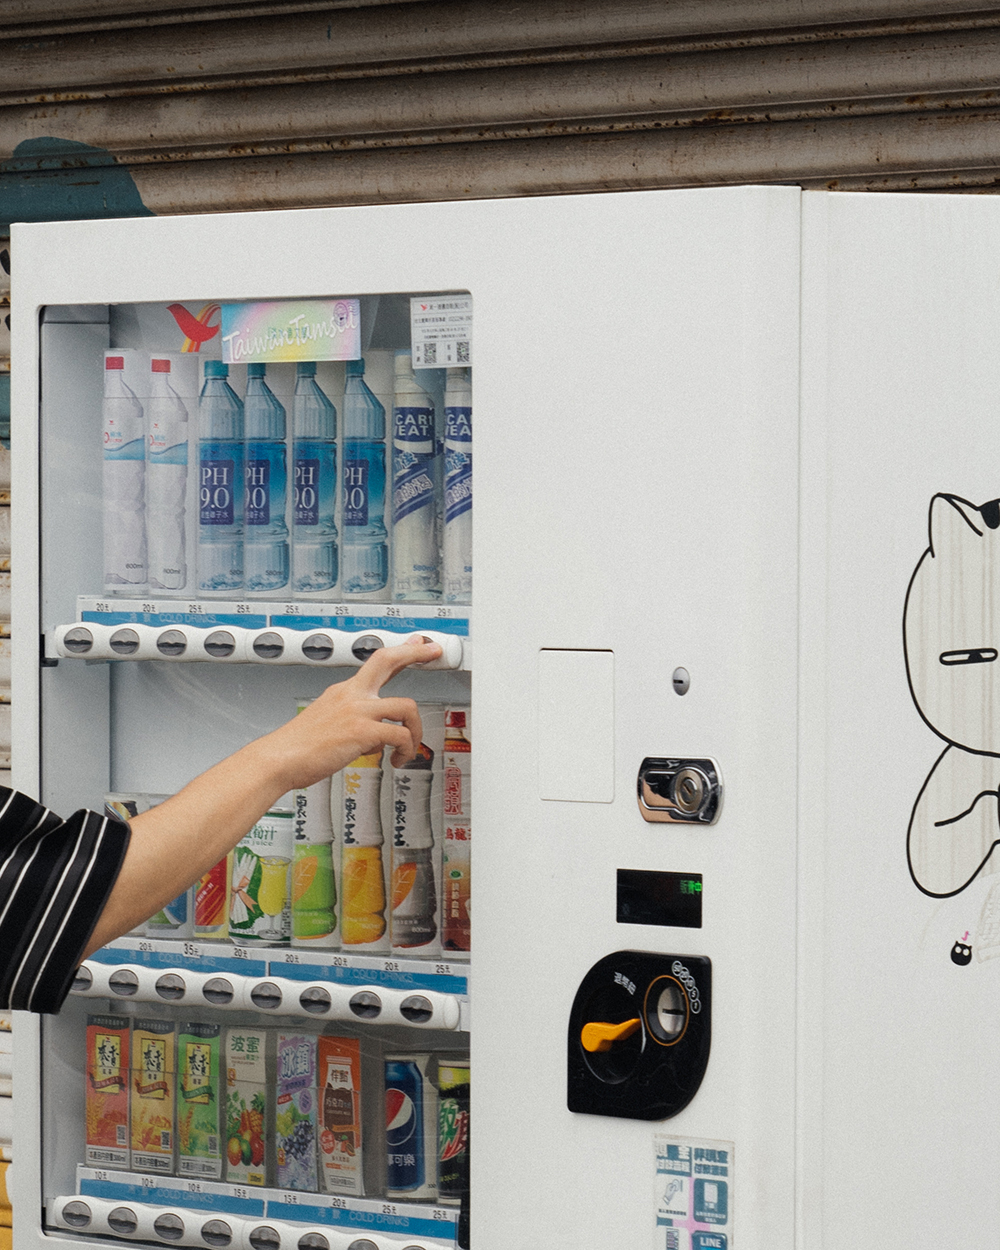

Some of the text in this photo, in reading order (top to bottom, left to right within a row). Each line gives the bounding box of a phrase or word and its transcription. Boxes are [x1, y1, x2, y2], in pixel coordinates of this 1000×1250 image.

[202, 467, 229, 485] PH
[200, 487, 230, 509] 9.0
[160, 613, 183, 623] COLD
[353, 617, 380, 627] COLD
[382, 618, 416, 628] DRINKS
[295, 788, 307, 841] 裏王
[446, 828, 472, 840] 烏龍
[231, 1035, 260, 1053] 波蜜
[350, 1211, 374, 1223] COLD
[376, 1214, 409, 1227] DRINKS
[700, 1237, 721, 1247] LINE
